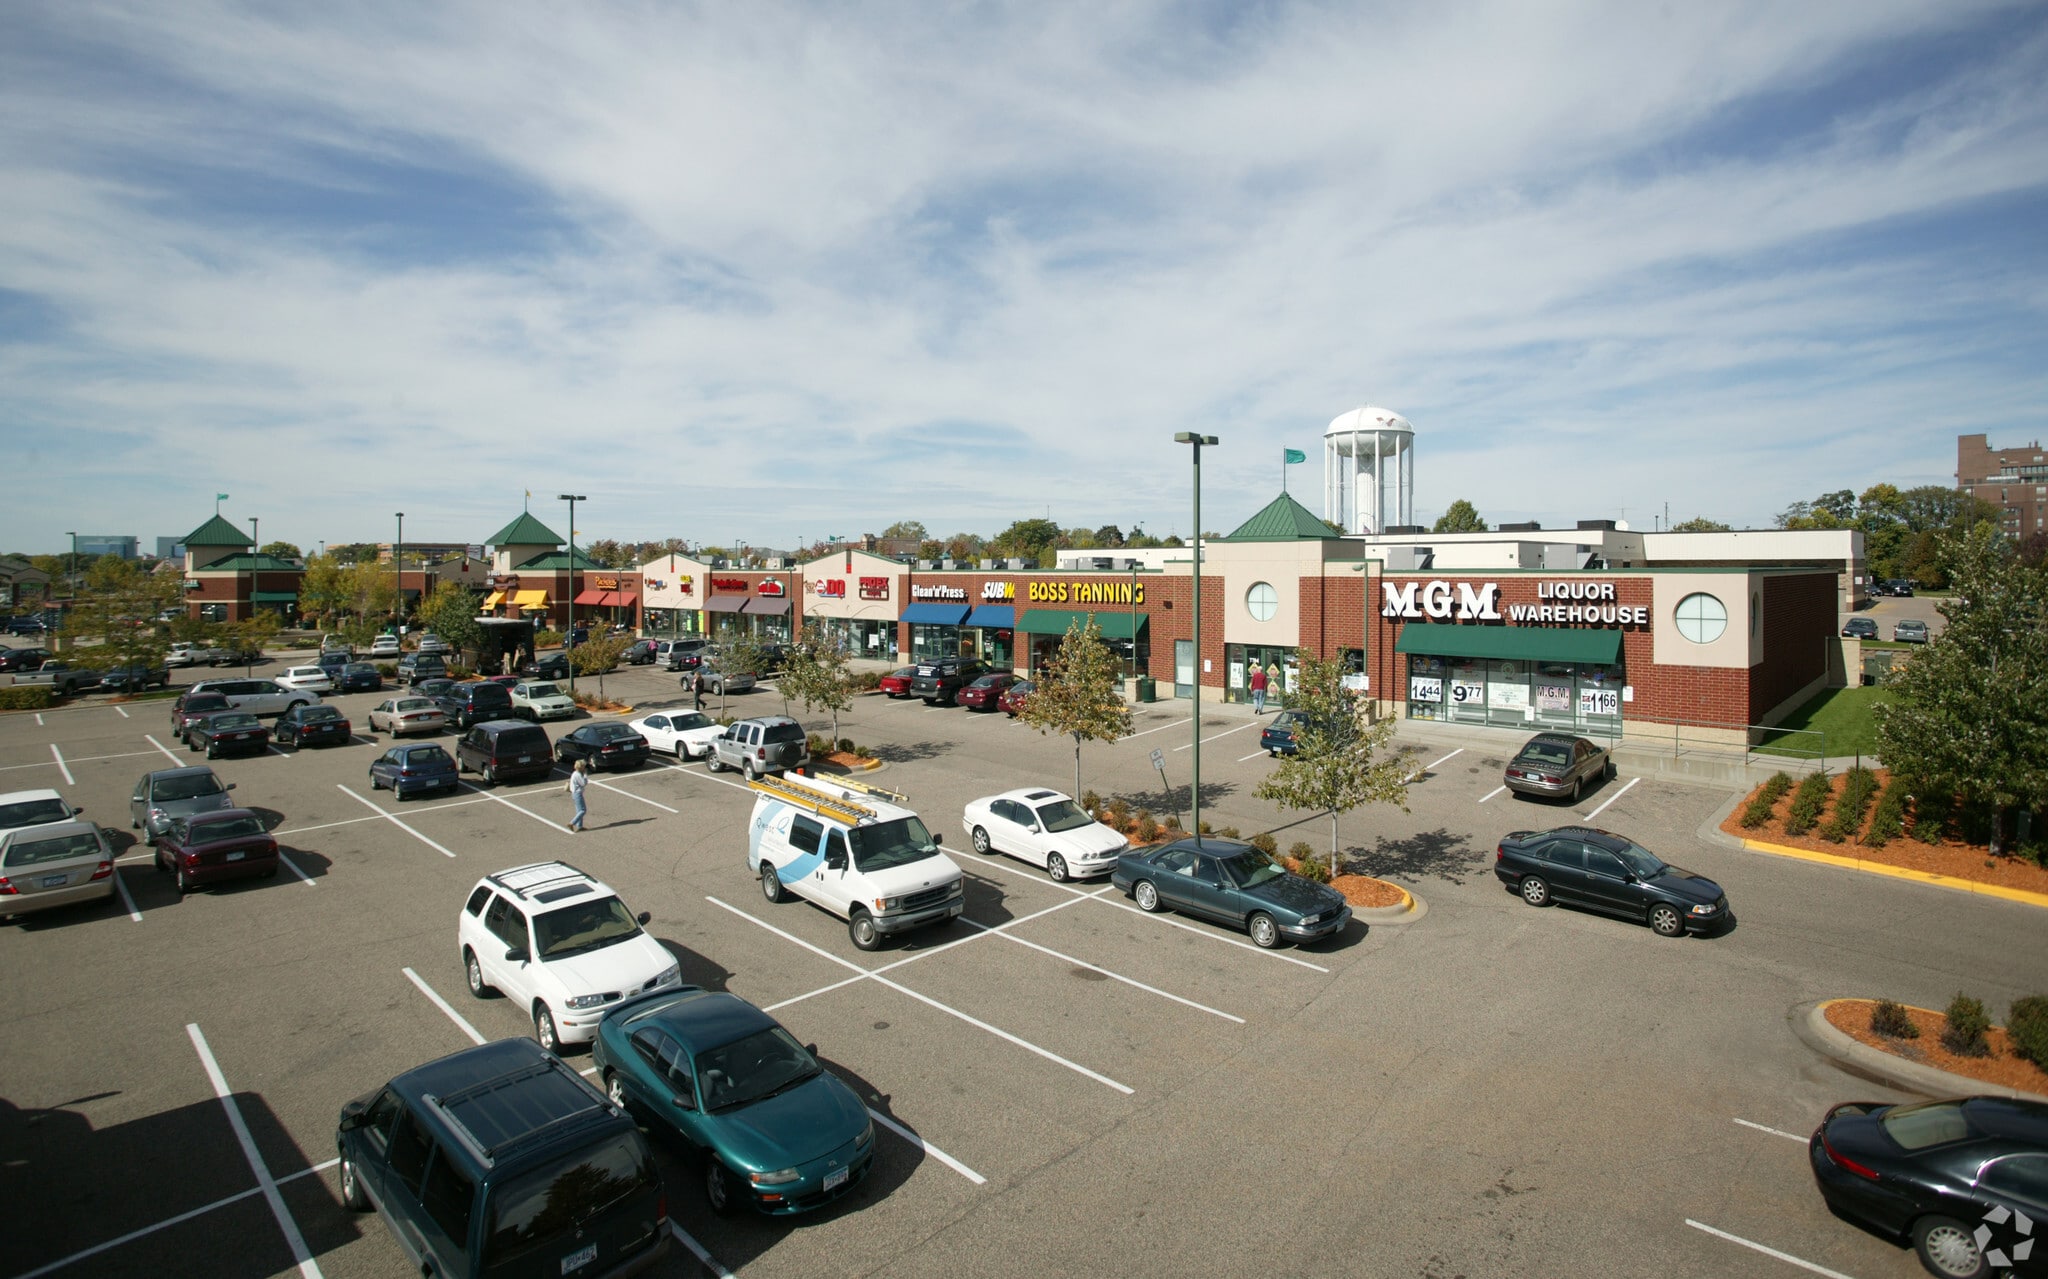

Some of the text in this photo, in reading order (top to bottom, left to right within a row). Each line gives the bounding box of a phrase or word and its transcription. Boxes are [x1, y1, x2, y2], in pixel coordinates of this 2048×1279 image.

[827, 579, 846, 598] DQ
[1029, 582, 1144, 603] BOSS TANNING
[1537, 583, 1613, 600] LIQUOR
[1509, 605, 1646, 624] WAREHOUSE
